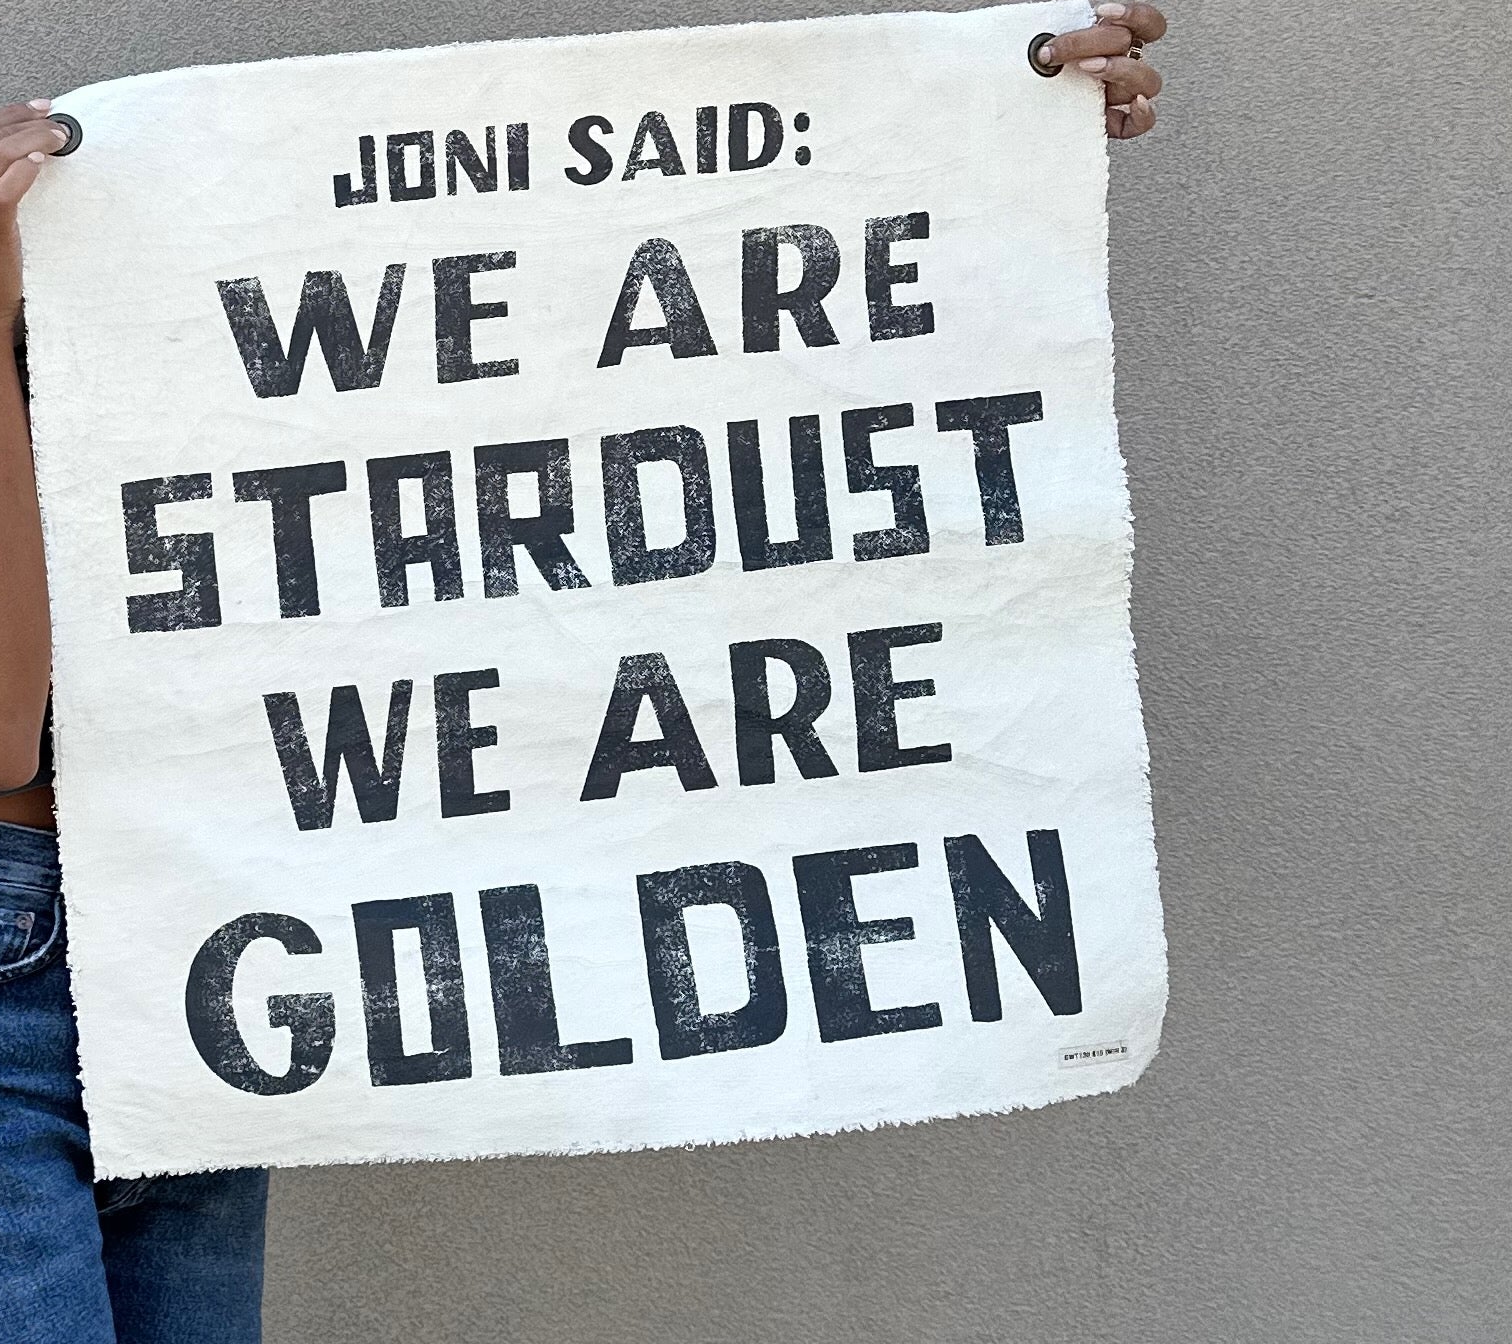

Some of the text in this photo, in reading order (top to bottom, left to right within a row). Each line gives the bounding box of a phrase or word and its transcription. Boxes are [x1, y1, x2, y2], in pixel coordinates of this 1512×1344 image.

[334, 102, 811, 208] JONI SAID:
[216, 212, 935, 398] WE ARE
[120, 391, 1043, 633] STARDUST
[263, 622, 952, 831] WE ARE
[185, 829, 1082, 1096] GOLDEN
